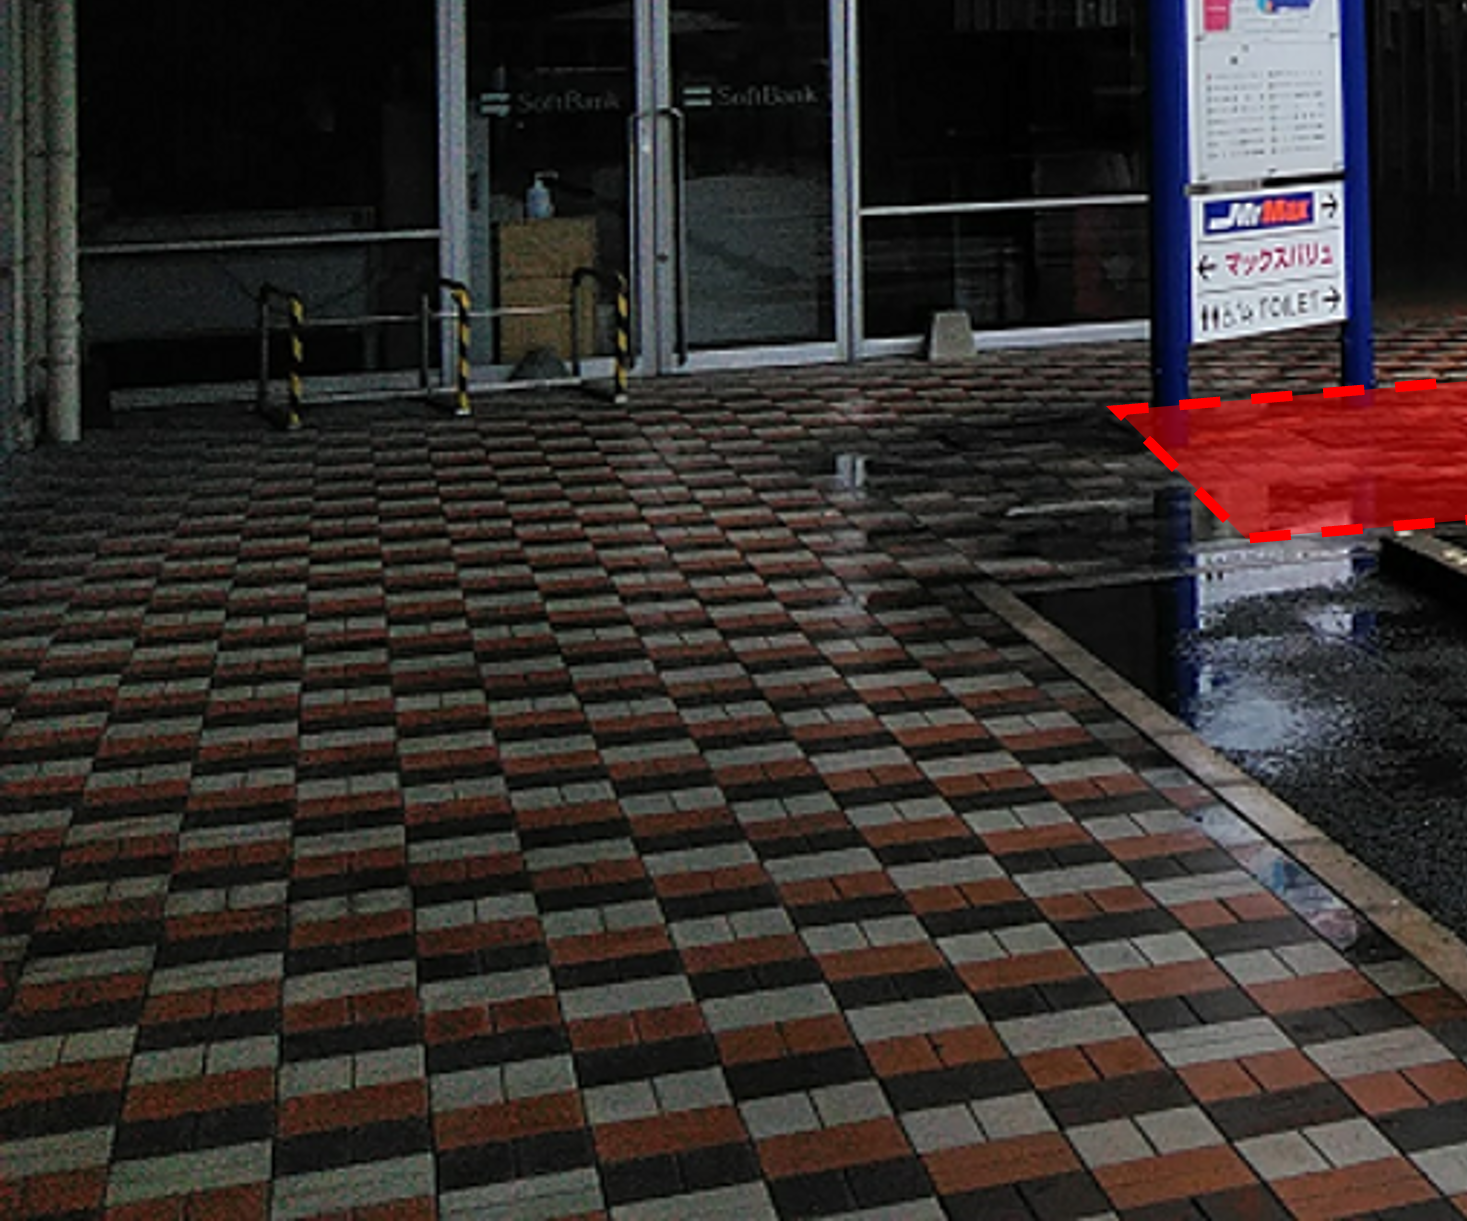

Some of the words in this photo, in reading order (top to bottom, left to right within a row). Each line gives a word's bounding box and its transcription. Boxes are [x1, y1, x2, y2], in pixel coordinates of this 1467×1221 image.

[1225, 243, 1333, 276] マックスバリュ
[1259, 290, 1320, 319] TOILET
